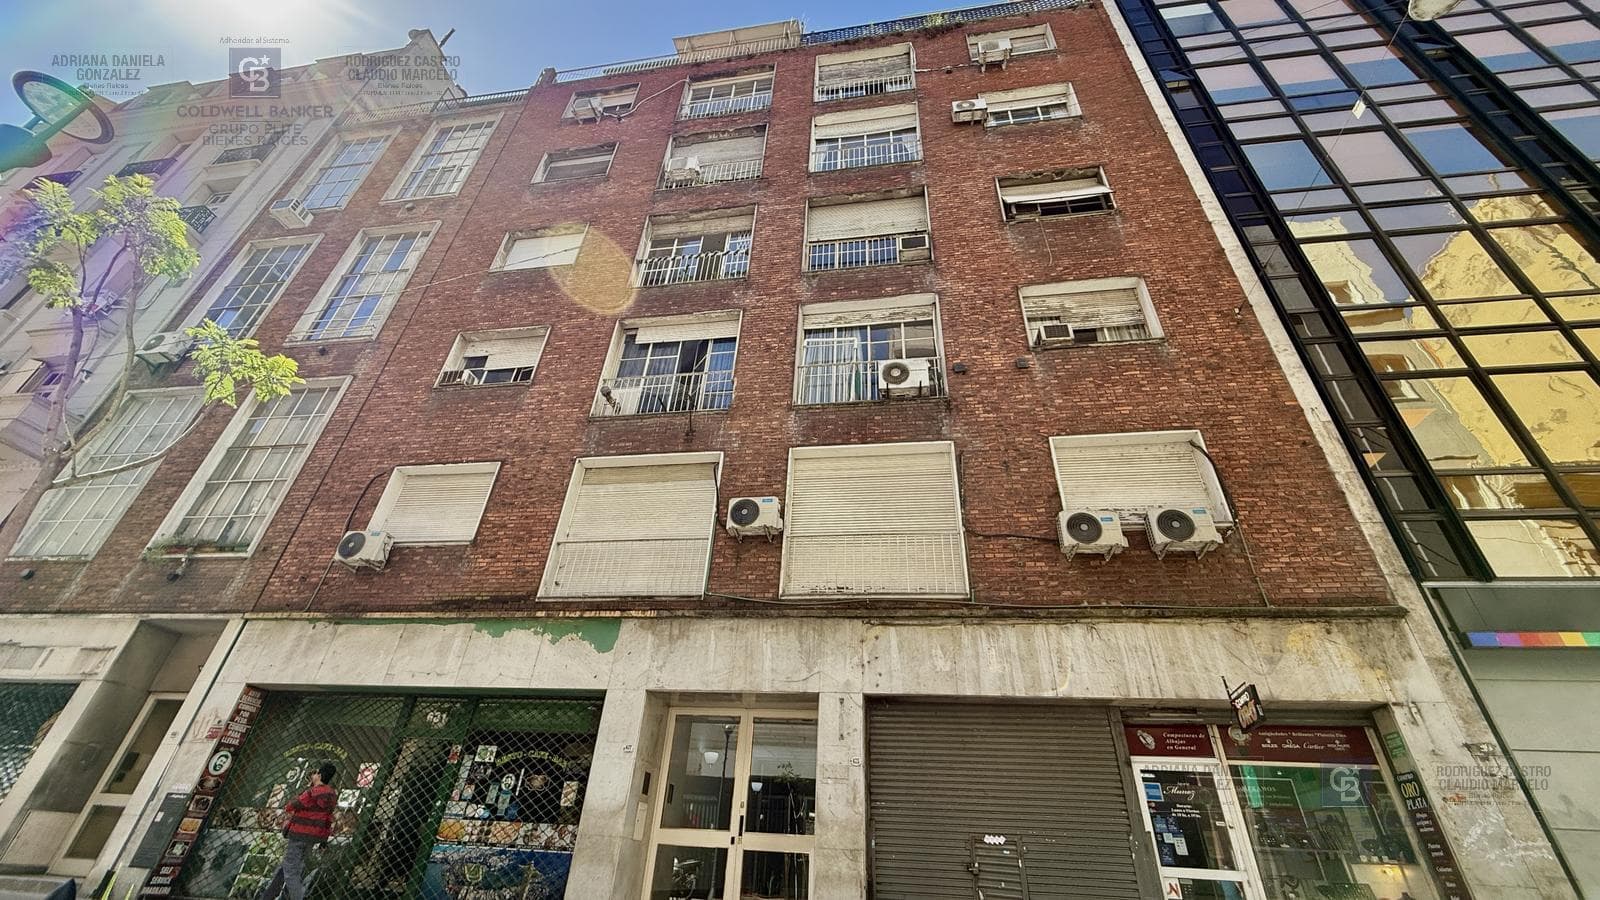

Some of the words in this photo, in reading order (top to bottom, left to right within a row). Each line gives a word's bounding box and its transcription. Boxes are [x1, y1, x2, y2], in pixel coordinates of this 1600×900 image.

[1303, 740, 1326, 750] Cartier
[1400, 781, 1420, 799] ORO
[1406, 797, 1428, 810] PLATA
